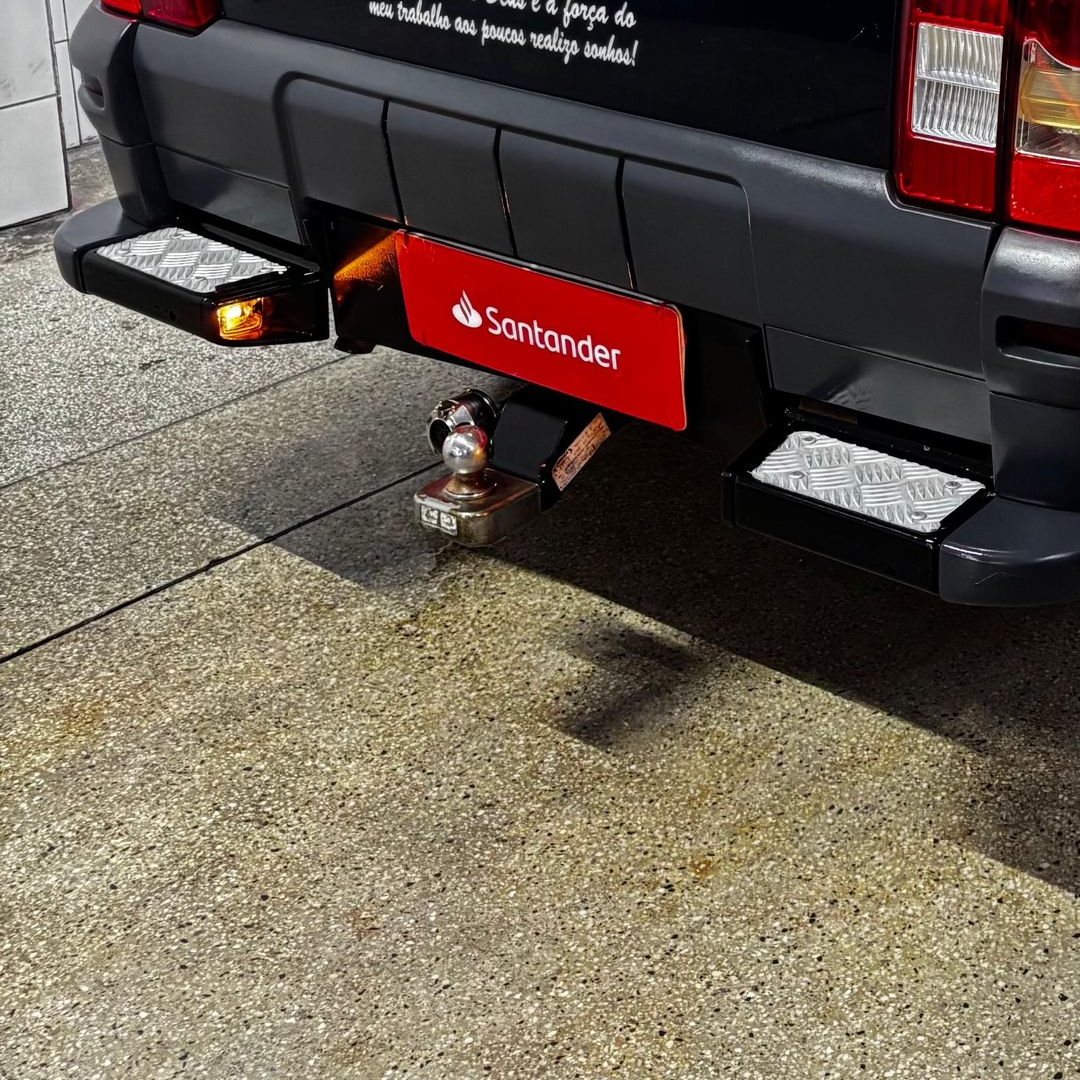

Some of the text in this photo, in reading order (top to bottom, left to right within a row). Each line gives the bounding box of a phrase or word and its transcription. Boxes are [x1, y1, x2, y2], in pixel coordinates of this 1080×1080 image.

[368, 0, 395, 19] meu
[454, 16, 478, 36] aos
[481, 18, 527, 46] poucos
[530, 26, 580, 64] realizo
[584, 34, 639, 66] sonhos!
[614, 1, 637, 29] do
[485, 306, 621, 370] Santander
